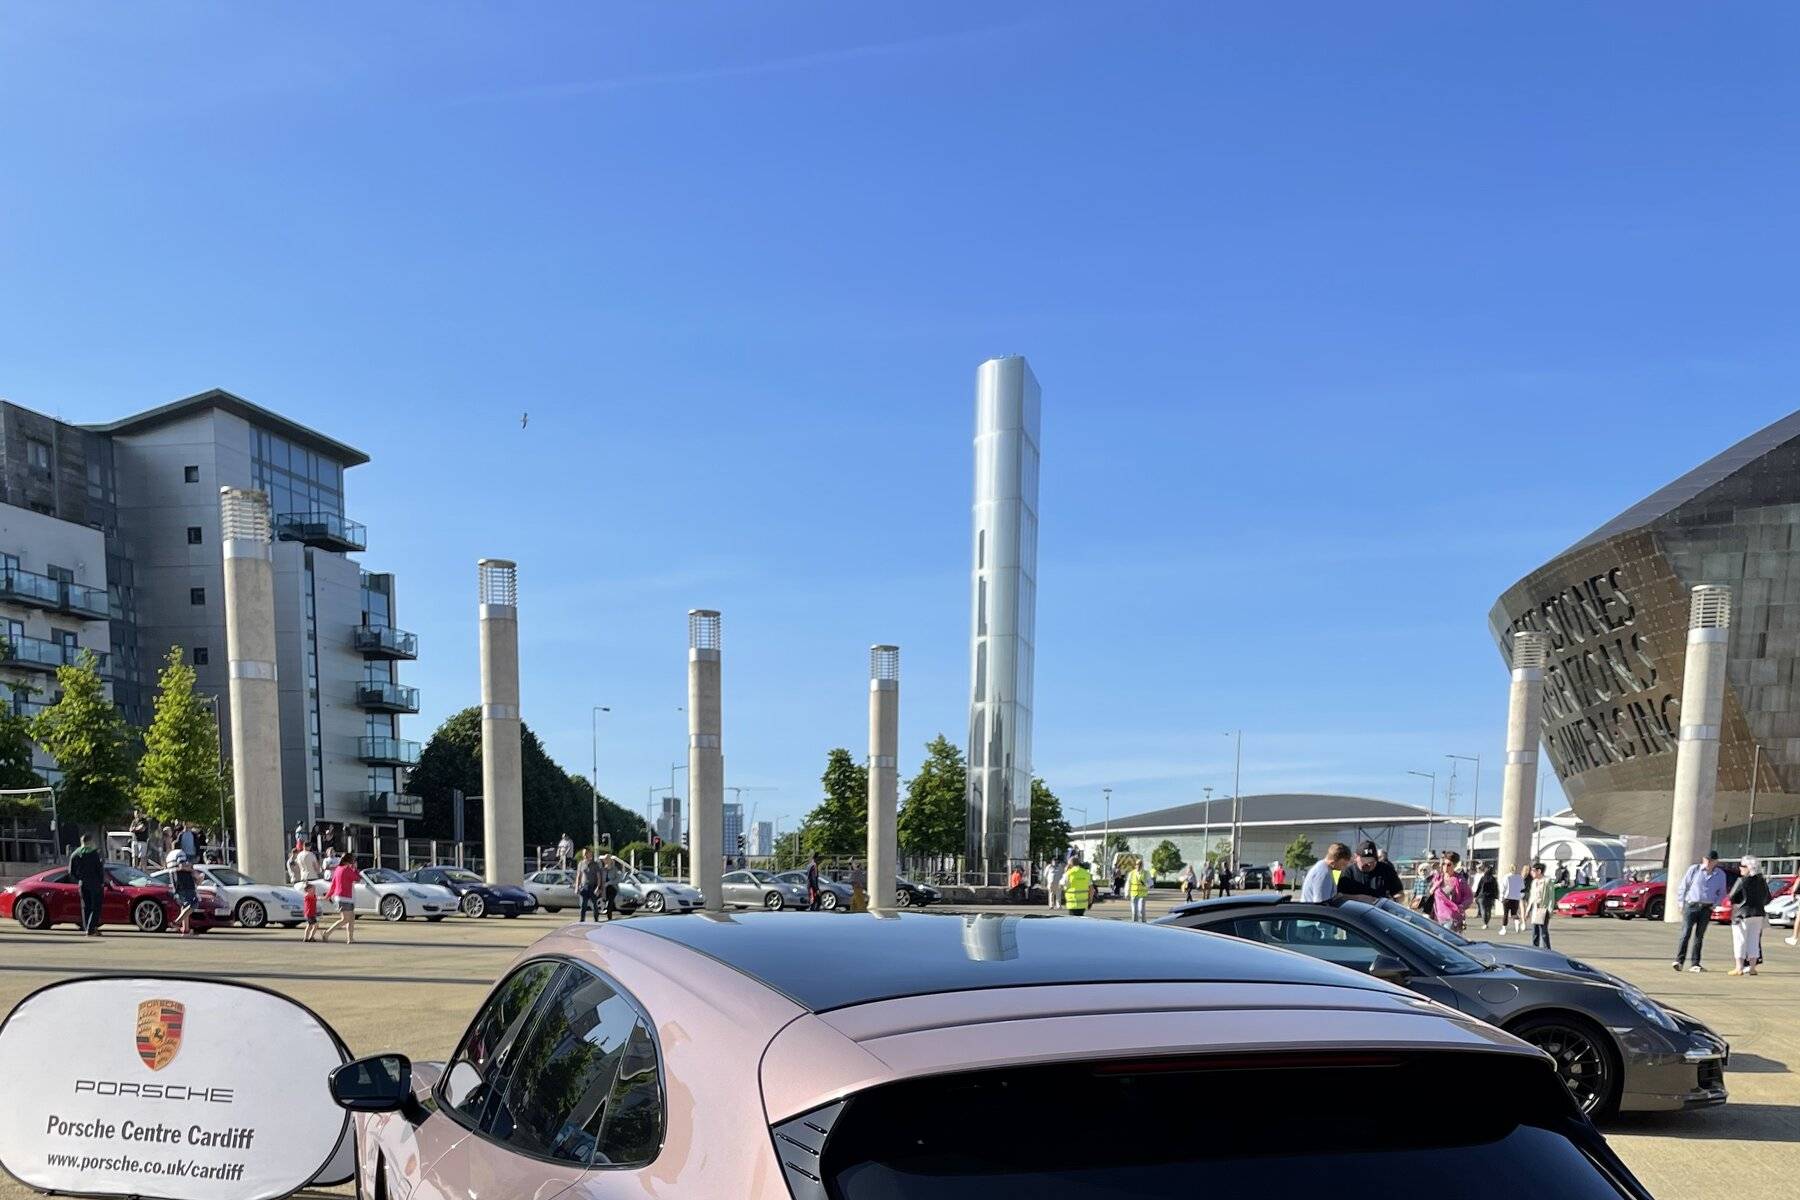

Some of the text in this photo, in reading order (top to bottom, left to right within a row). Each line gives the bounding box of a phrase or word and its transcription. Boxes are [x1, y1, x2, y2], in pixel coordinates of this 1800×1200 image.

[1541, 567, 1635, 652] STONES
[75, 1080, 234, 1103] PORSCHE
[47, 1115, 255, 1149] Porsche Centre Cardiff
[47, 1152, 245, 1181] www.porsche.co.uk/cardiff
